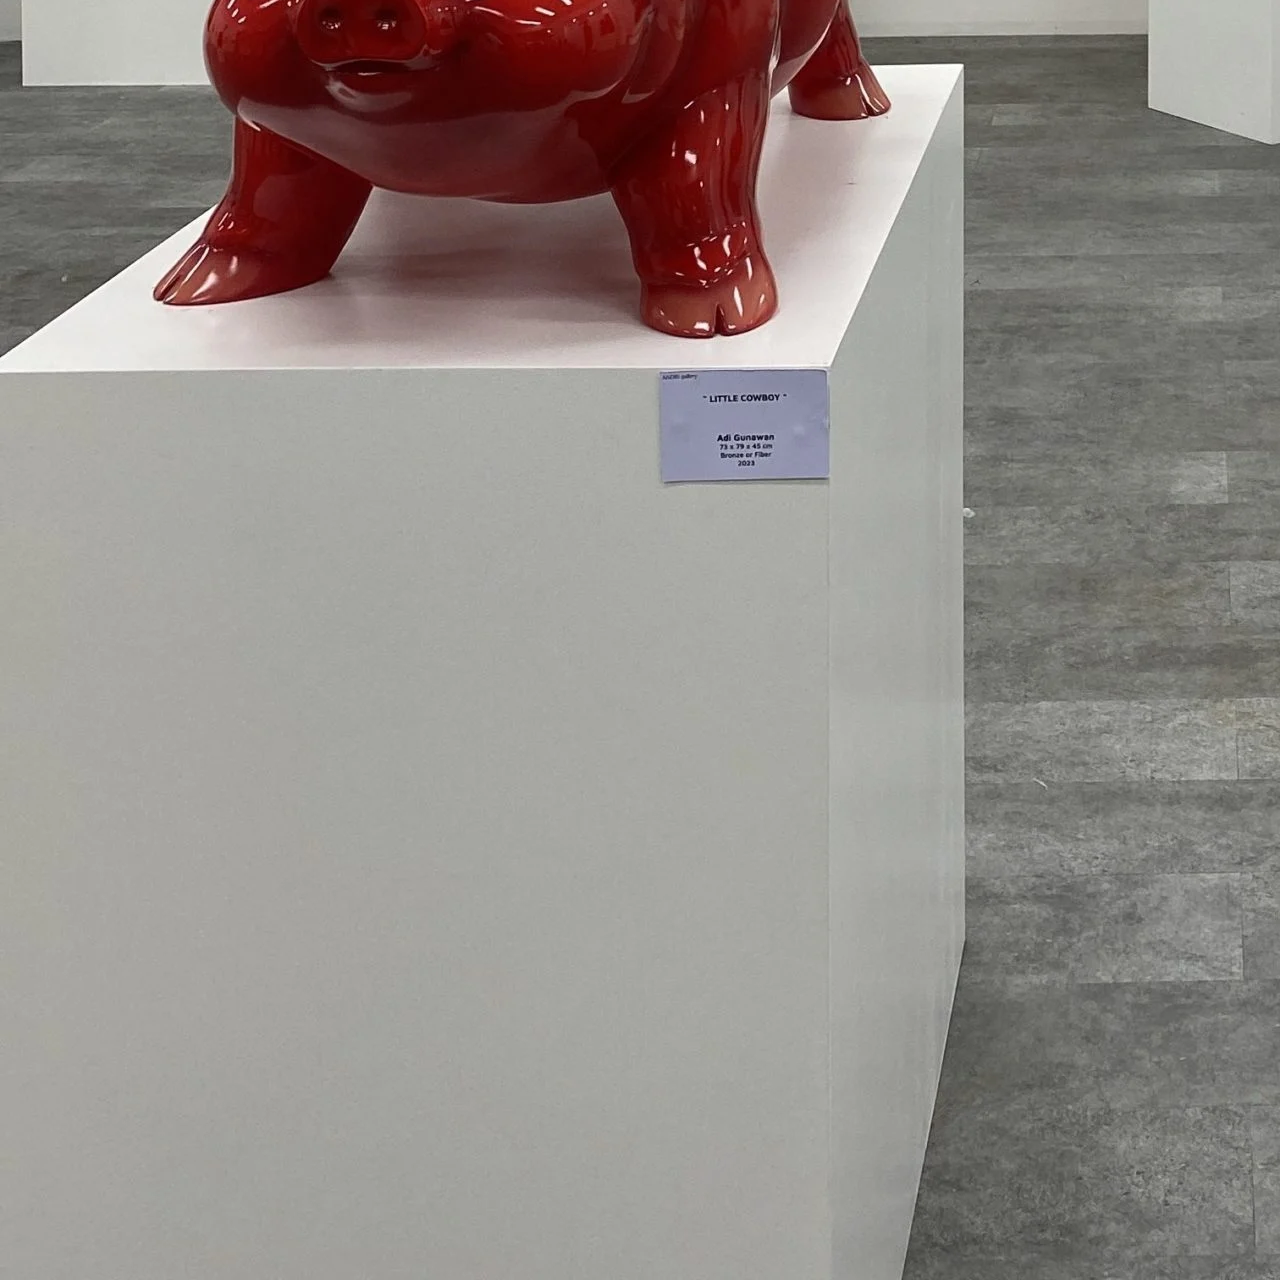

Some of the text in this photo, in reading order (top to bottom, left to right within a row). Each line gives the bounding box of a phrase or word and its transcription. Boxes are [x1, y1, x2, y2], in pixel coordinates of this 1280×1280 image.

[709, 393, 781, 403] LITTLE COWBOY
[716, 433, 775, 442] Adi Gunawan
